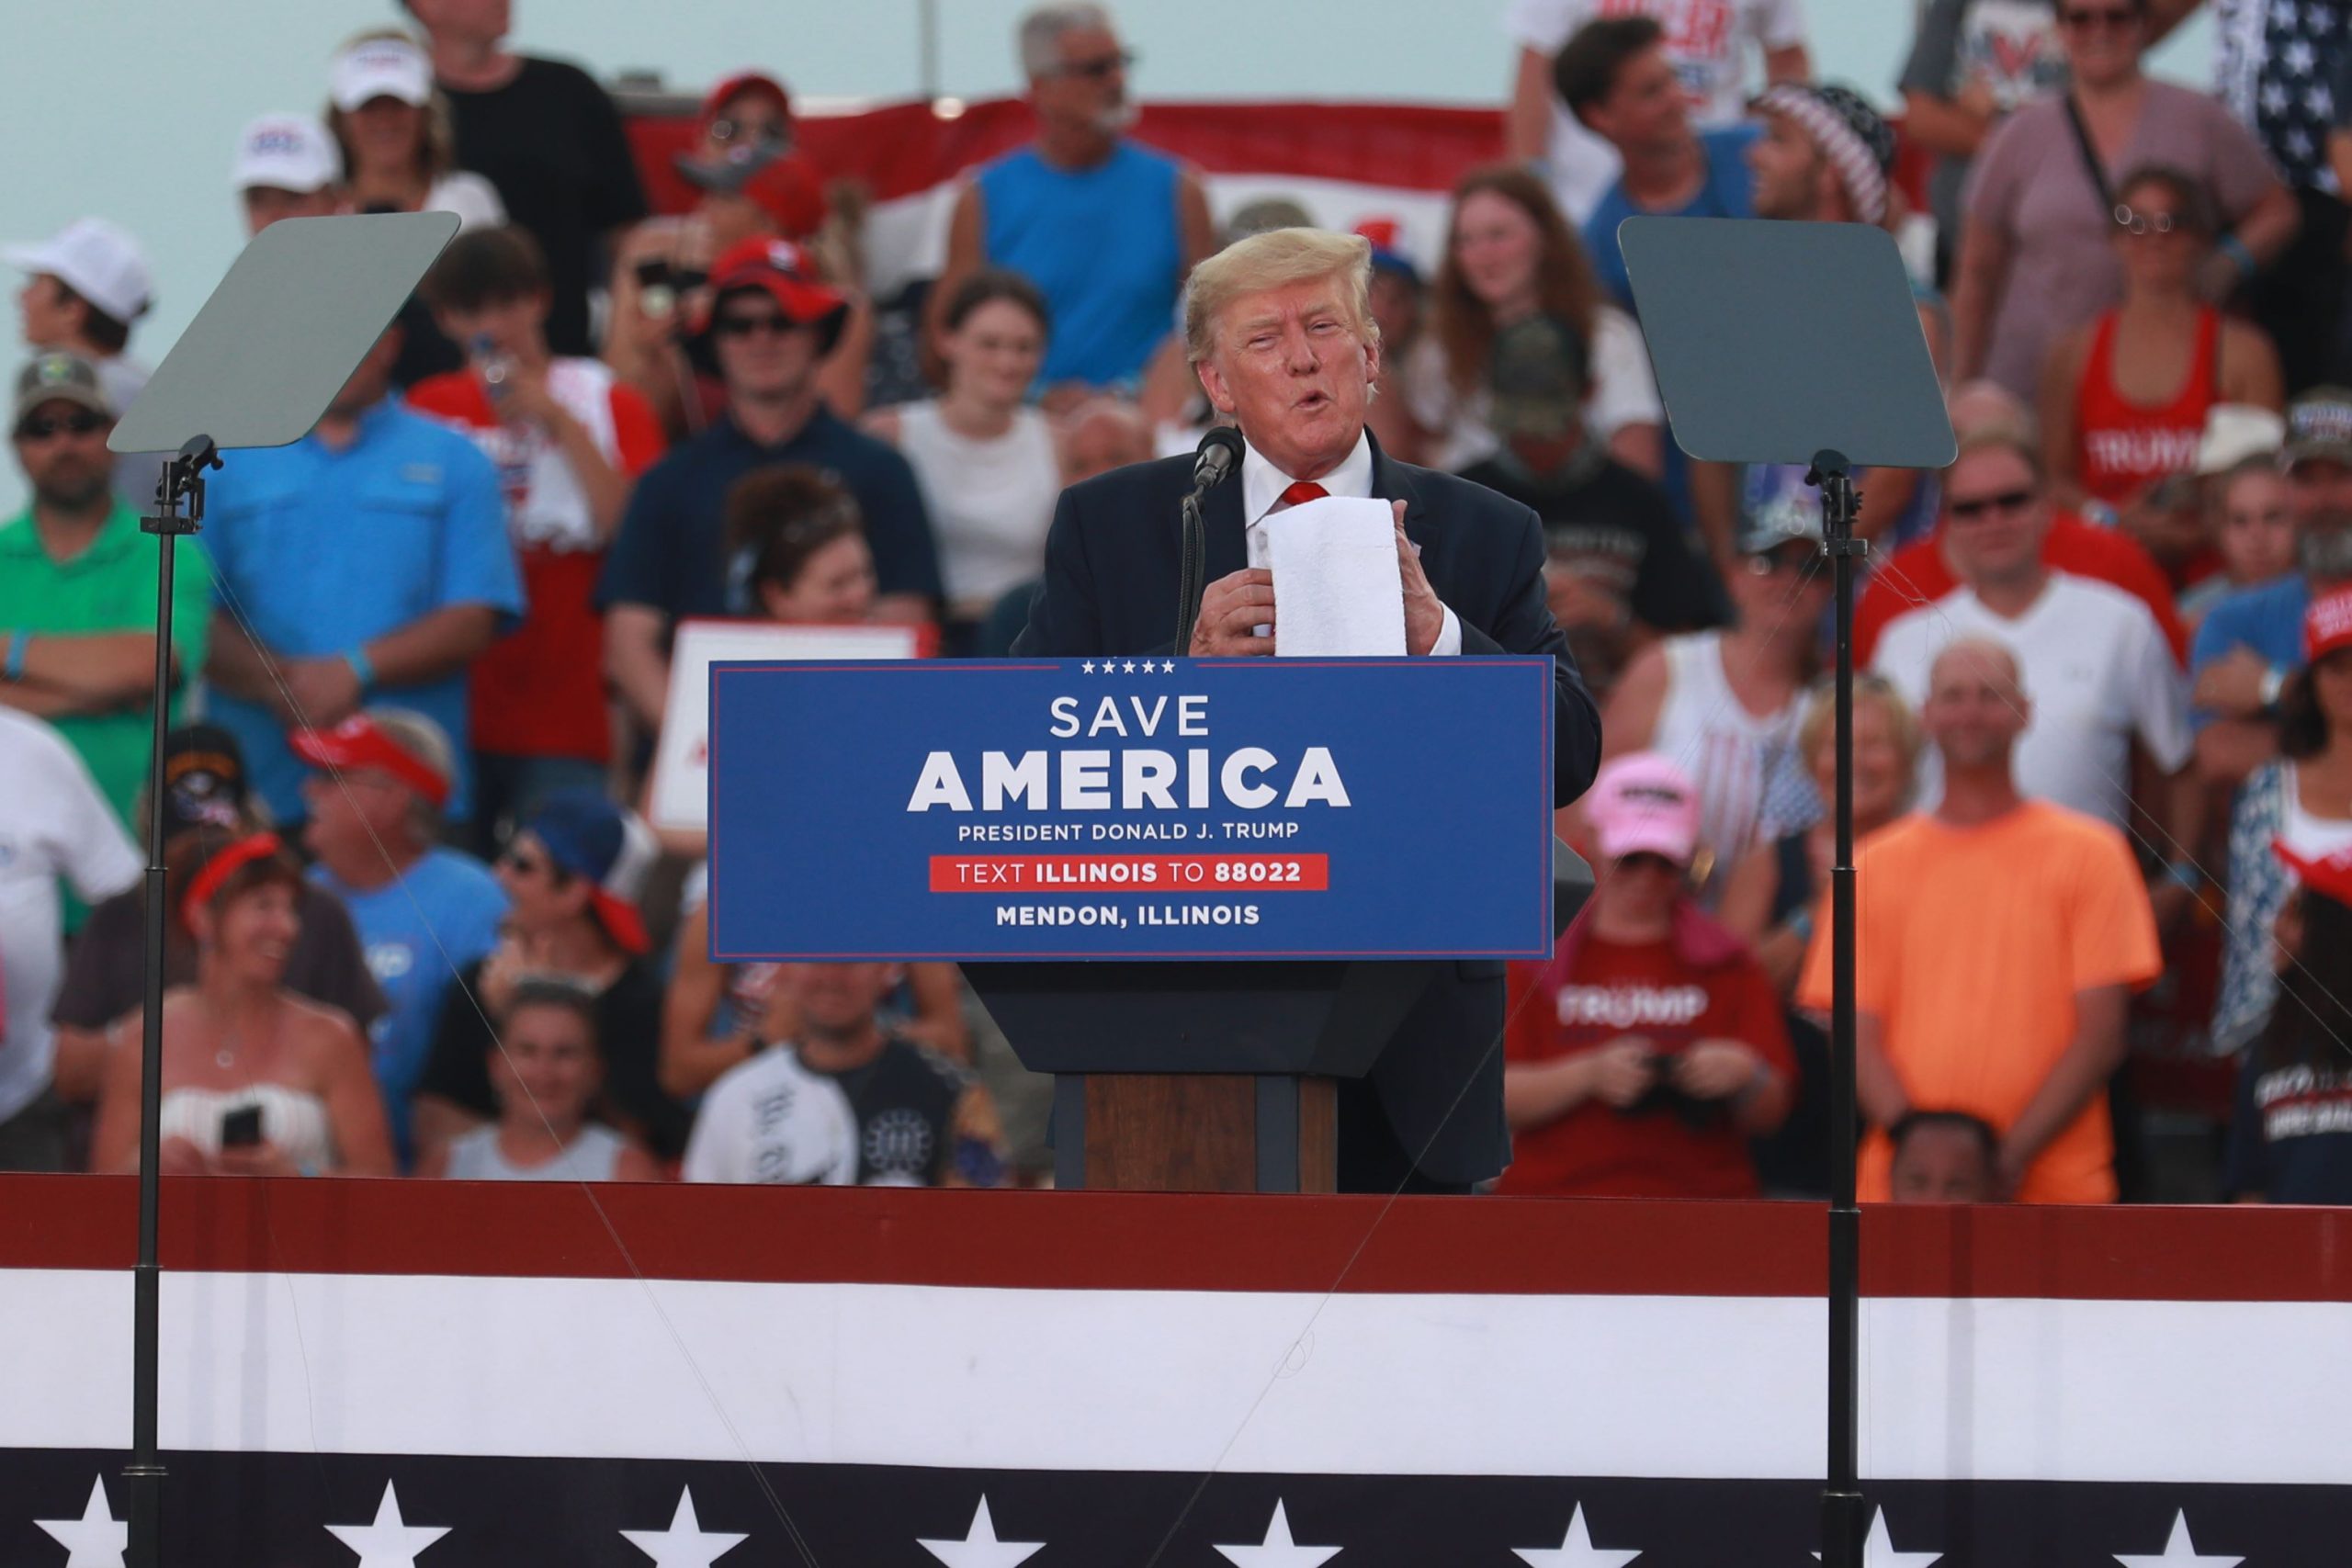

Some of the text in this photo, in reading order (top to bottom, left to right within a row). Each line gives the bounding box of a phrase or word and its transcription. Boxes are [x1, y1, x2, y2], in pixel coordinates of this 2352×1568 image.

[2085, 429, 2201, 472] TRUM
[1049, 695, 1209, 738] SAVE
[906, 747, 1351, 812] AMERICA
[958, 822, 1299, 841] PRESIDENT DONALD J. TRUMP
[956, 862, 1301, 884] TEXT ILLINOIS TO 88022
[997, 905, 1260, 929] MENDON, ILLINOIS
[1557, 985, 1709, 1029] TRUMP
